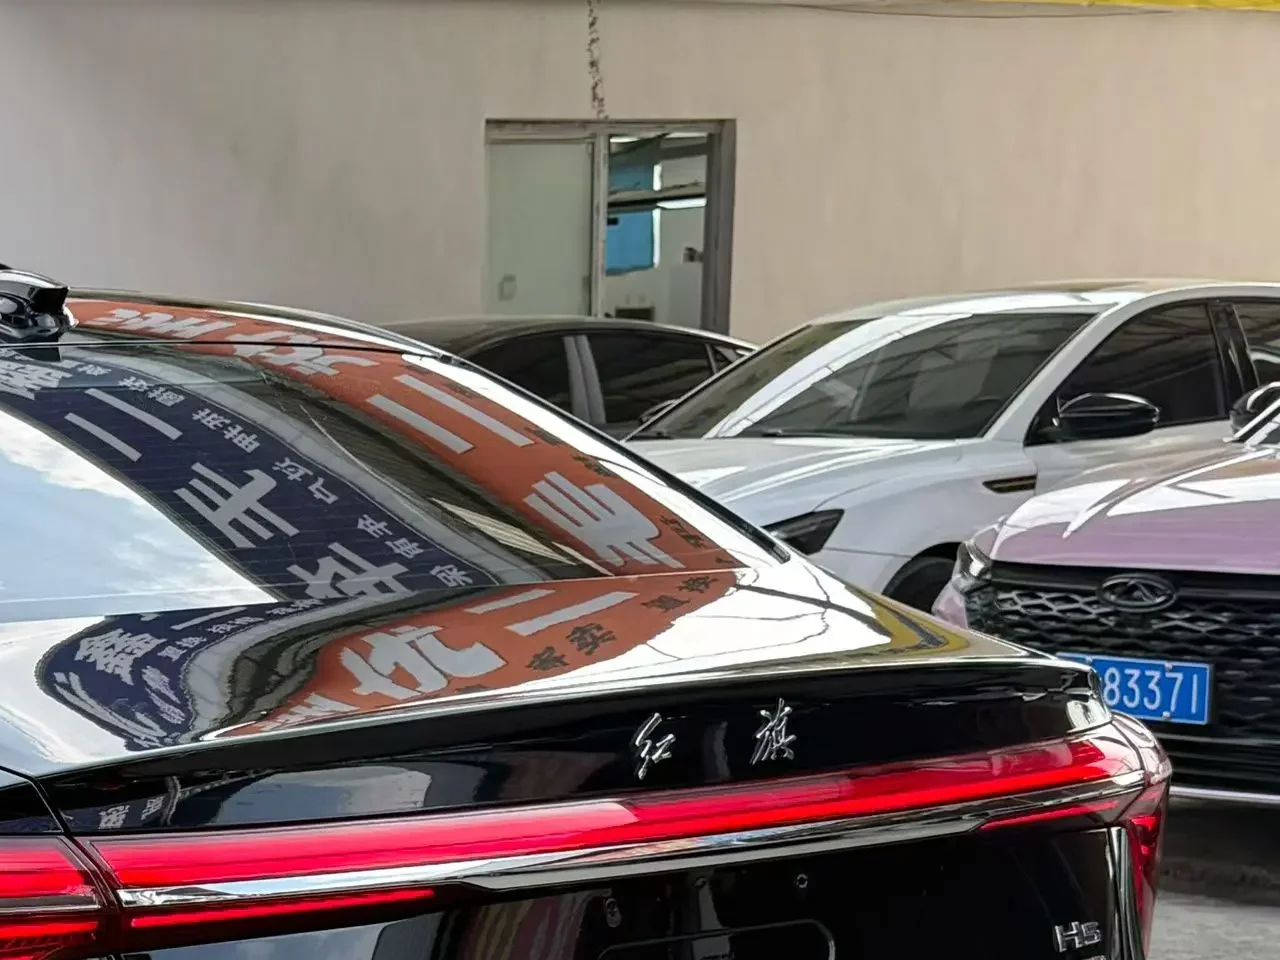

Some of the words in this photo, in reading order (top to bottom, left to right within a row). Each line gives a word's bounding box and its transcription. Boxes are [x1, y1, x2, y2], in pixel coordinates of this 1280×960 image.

[1103, 667, 1198, 714] 83371
[635, 697, 797, 780] 红旗
[1054, 921, 1101, 952] H5
